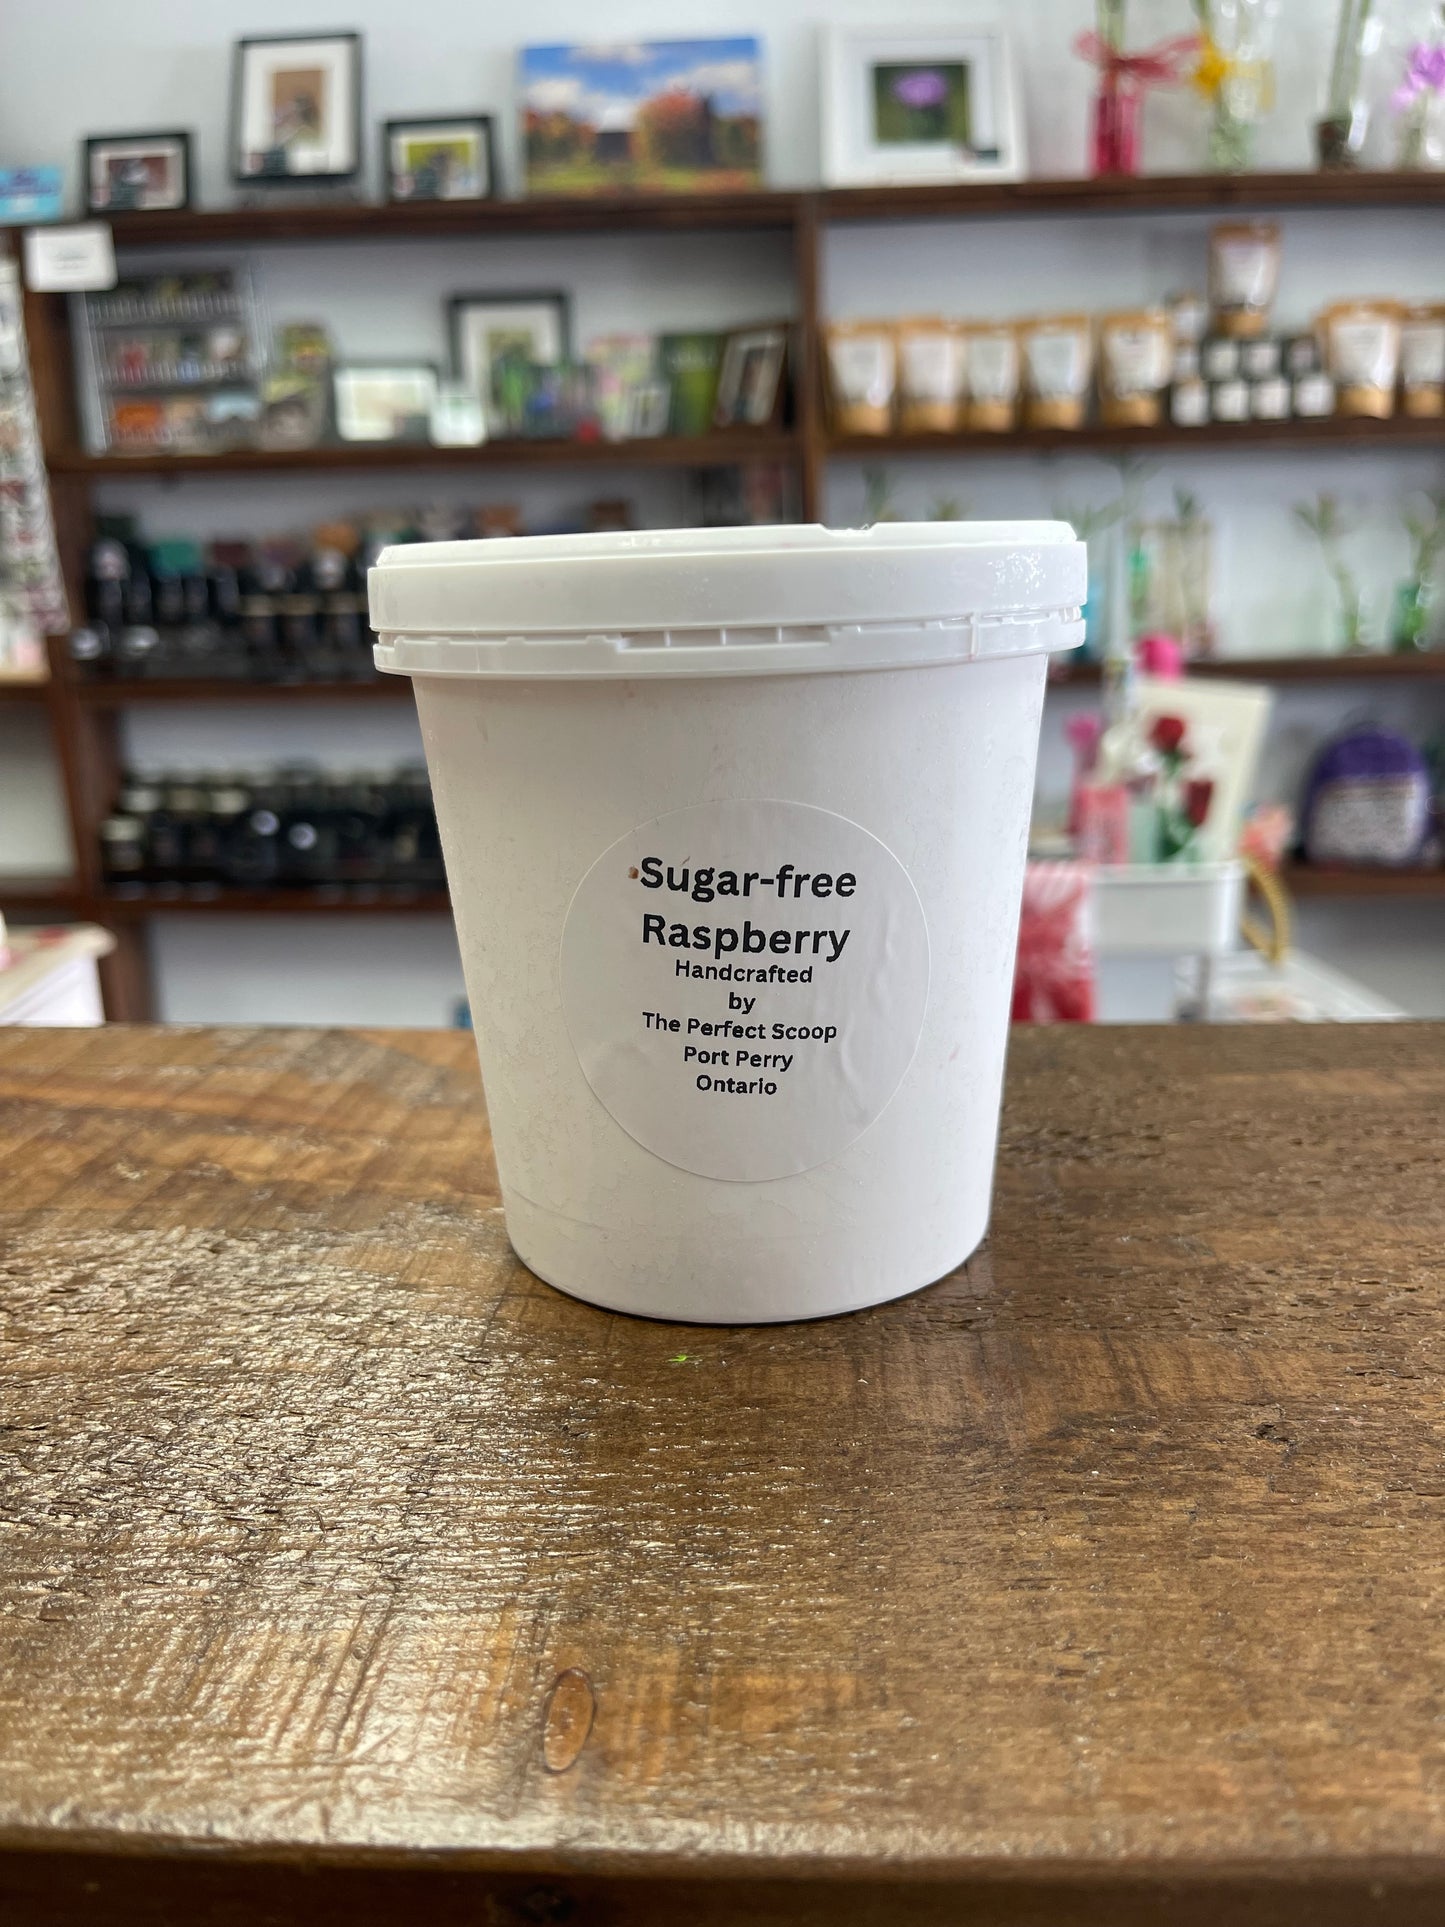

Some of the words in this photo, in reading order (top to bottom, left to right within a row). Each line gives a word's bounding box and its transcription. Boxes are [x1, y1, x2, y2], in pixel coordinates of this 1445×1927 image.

[640, 856, 857, 903] Sugar-free
[642, 913, 851, 962] Raspberry
[675, 959, 813, 983] Handcrafted
[728, 991, 757, 1015] by
[642, 1011, 681, 1032] The
[687, 1017, 767, 1040] Perfect
[771, 1023, 838, 1043] Scoop
[683, 1045, 730, 1067] Port
[735, 1049, 794, 1073] Perry
[696, 1074, 778, 1095] Ontario
